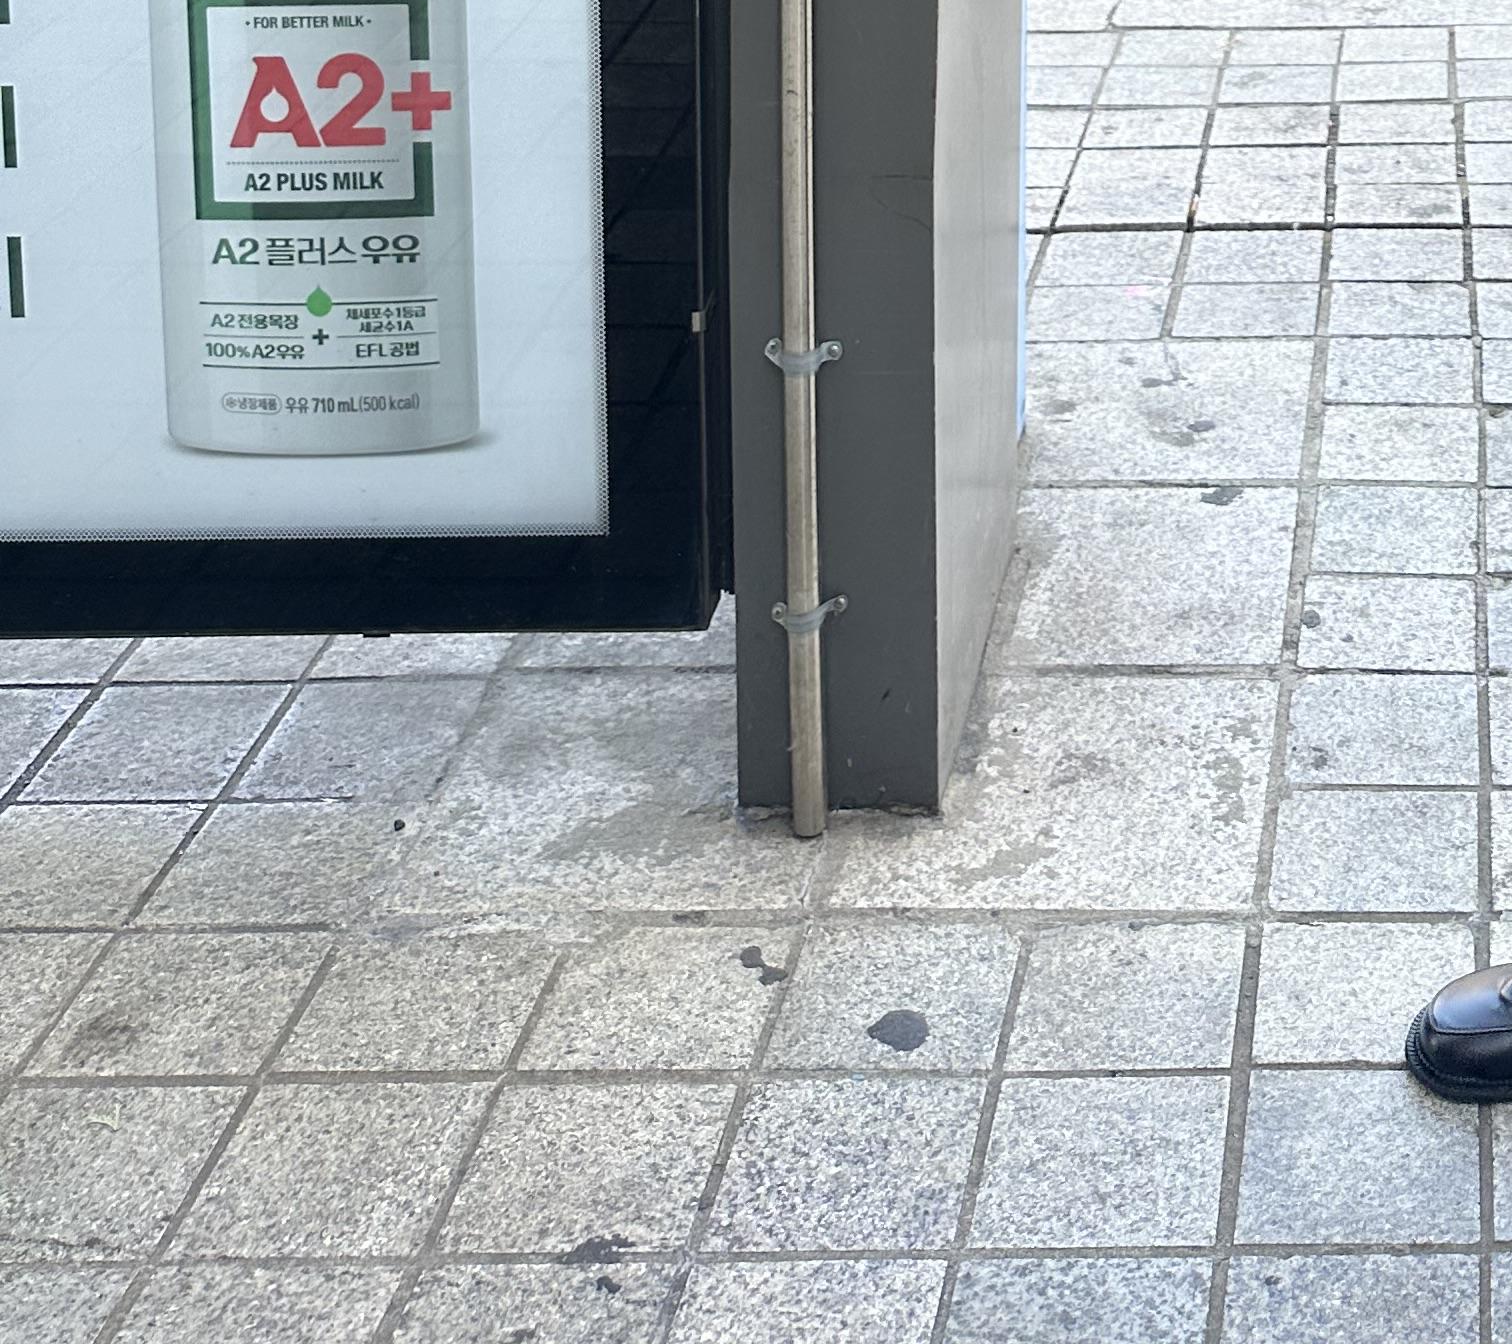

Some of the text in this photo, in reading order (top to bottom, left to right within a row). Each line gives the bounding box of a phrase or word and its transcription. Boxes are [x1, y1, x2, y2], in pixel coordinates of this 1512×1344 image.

[253, 15, 364, 30] FOR BETTER MILK
[244, 171, 384, 192] A2 PLUS MILK
[285, 396, 309, 413] 우유
[312, 397, 334, 413] 710
